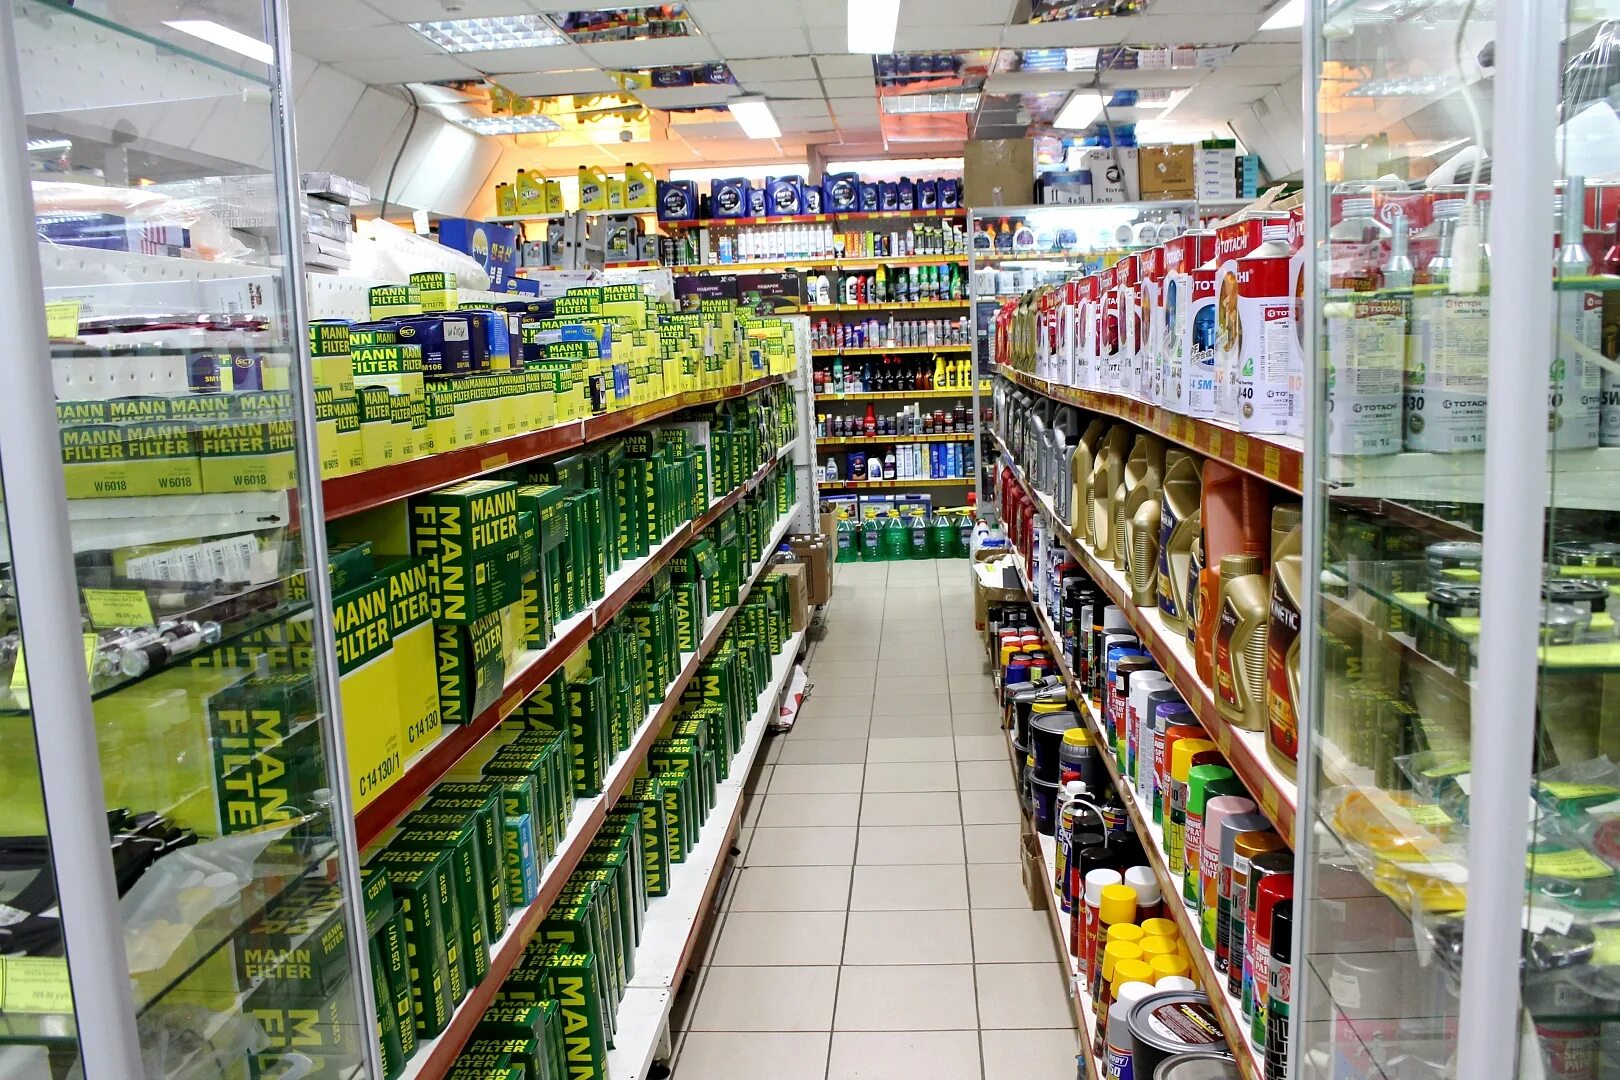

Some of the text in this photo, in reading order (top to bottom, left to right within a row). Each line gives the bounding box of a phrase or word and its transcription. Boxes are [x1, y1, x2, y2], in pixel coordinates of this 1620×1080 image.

[1220, 236, 1248, 254] TOTACHI
[411, 274, 442, 282] MANN
[372, 288, 405, 296] MANN
[604, 285, 635, 294] MANN
[605, 293, 636, 301] FILTER
[372, 296, 406, 305] FILTER
[556, 298, 587, 306] MANN
[556, 305, 588, 314] FILTER
[321, 325, 349, 339] MANN
[322, 341, 350, 353] FILTER
[402, 348, 421, 359] MANN
[549, 343, 583, 354] MANN
[403, 359, 422, 371] FILTER
[364, 390, 389, 404] MANN
[390, 395, 410, 408] MANN
[434, 391, 454, 404] MANN
[111, 398, 228, 416] MANN MANN
[365, 405, 389, 417] FILTER
[391, 408, 411, 420] FILTER
[435, 404, 454, 417] FILTER
[64, 430, 121, 446] MANN
[128, 426, 188, 439] MANN
[202, 423, 263, 438] MANN
[65, 444, 123, 460] FILTER
[129, 442, 189, 456] FILTER
[204, 438, 264, 453] FILTER
[778, 476, 786, 513] MANN
[471, 490, 516, 523] MANN
[472, 516, 517, 550] FILTER
[439, 506, 466, 620] MANN
[390, 564, 427, 601] ANN
[391, 592, 429, 629] LTER
[676, 591, 691, 649] MANN
[768, 616, 778, 653] MANN
[474, 630, 502, 661] FILTER
[439, 625, 461, 720] MANN
[425, 710, 438, 732] 130
[665, 793, 681, 860] MANN
[643, 807, 661, 892] MANN
[506, 831, 524, 903] MANN
[244, 949, 311, 964] MANN
[245, 965, 312, 979] FILTER
[400, 1021, 408, 1054] MANN
[405, 1016, 414, 1050] FILTER
